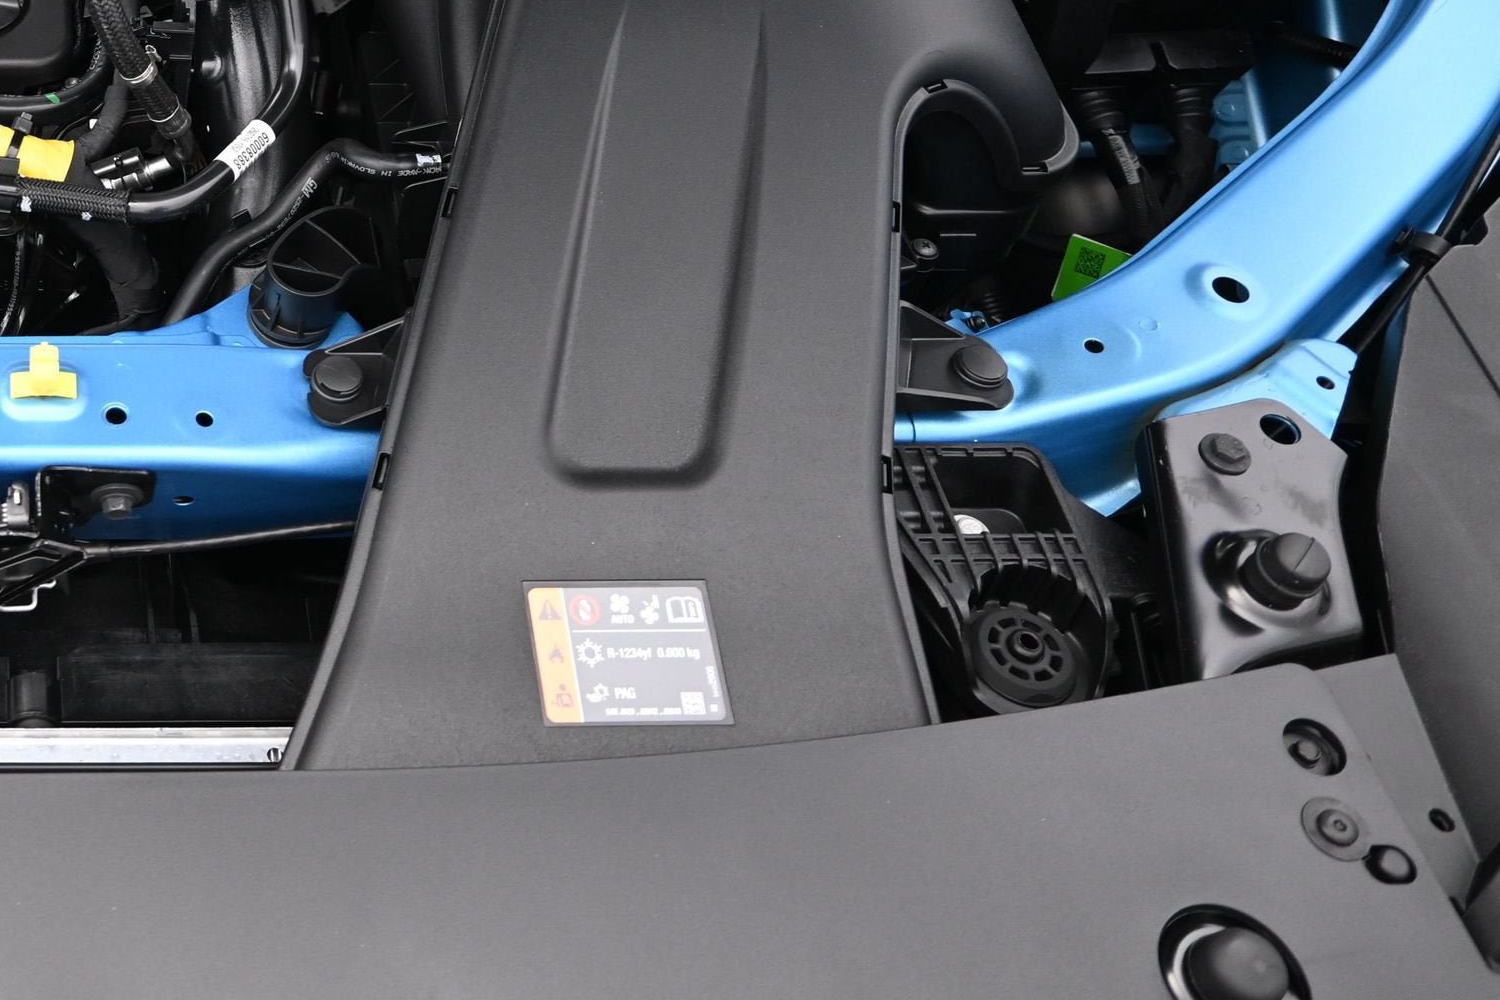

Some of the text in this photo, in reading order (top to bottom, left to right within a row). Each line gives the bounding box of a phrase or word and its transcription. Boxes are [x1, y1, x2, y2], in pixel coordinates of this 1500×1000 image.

[611, 613, 635, 624] AUTO
[686, 647, 701, 660] kg
[614, 687, 636, 699] PAG
